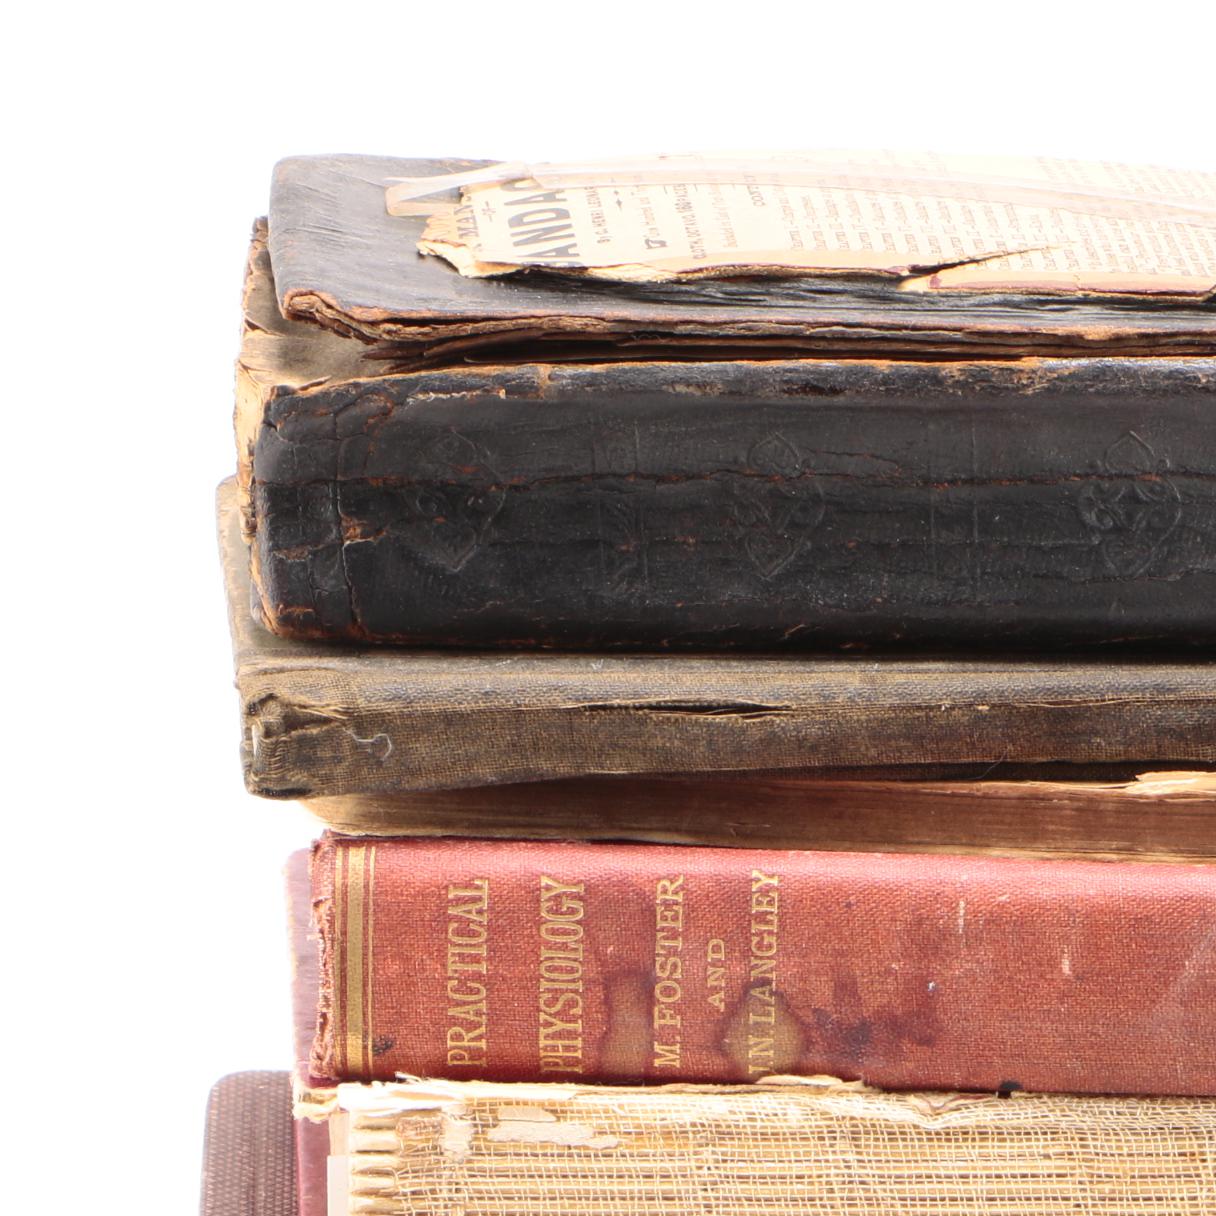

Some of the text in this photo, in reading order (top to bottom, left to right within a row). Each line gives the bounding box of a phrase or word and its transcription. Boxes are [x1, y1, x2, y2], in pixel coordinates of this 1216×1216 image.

[447, 878, 489, 1068] PRACTICAL
[539, 875, 585, 1074] PHYSIOLOGY
[653, 874, 684, 1031] FOSTER
[706, 937, 726, 1013] AND
[749, 868, 780, 1026] LANGLEY
